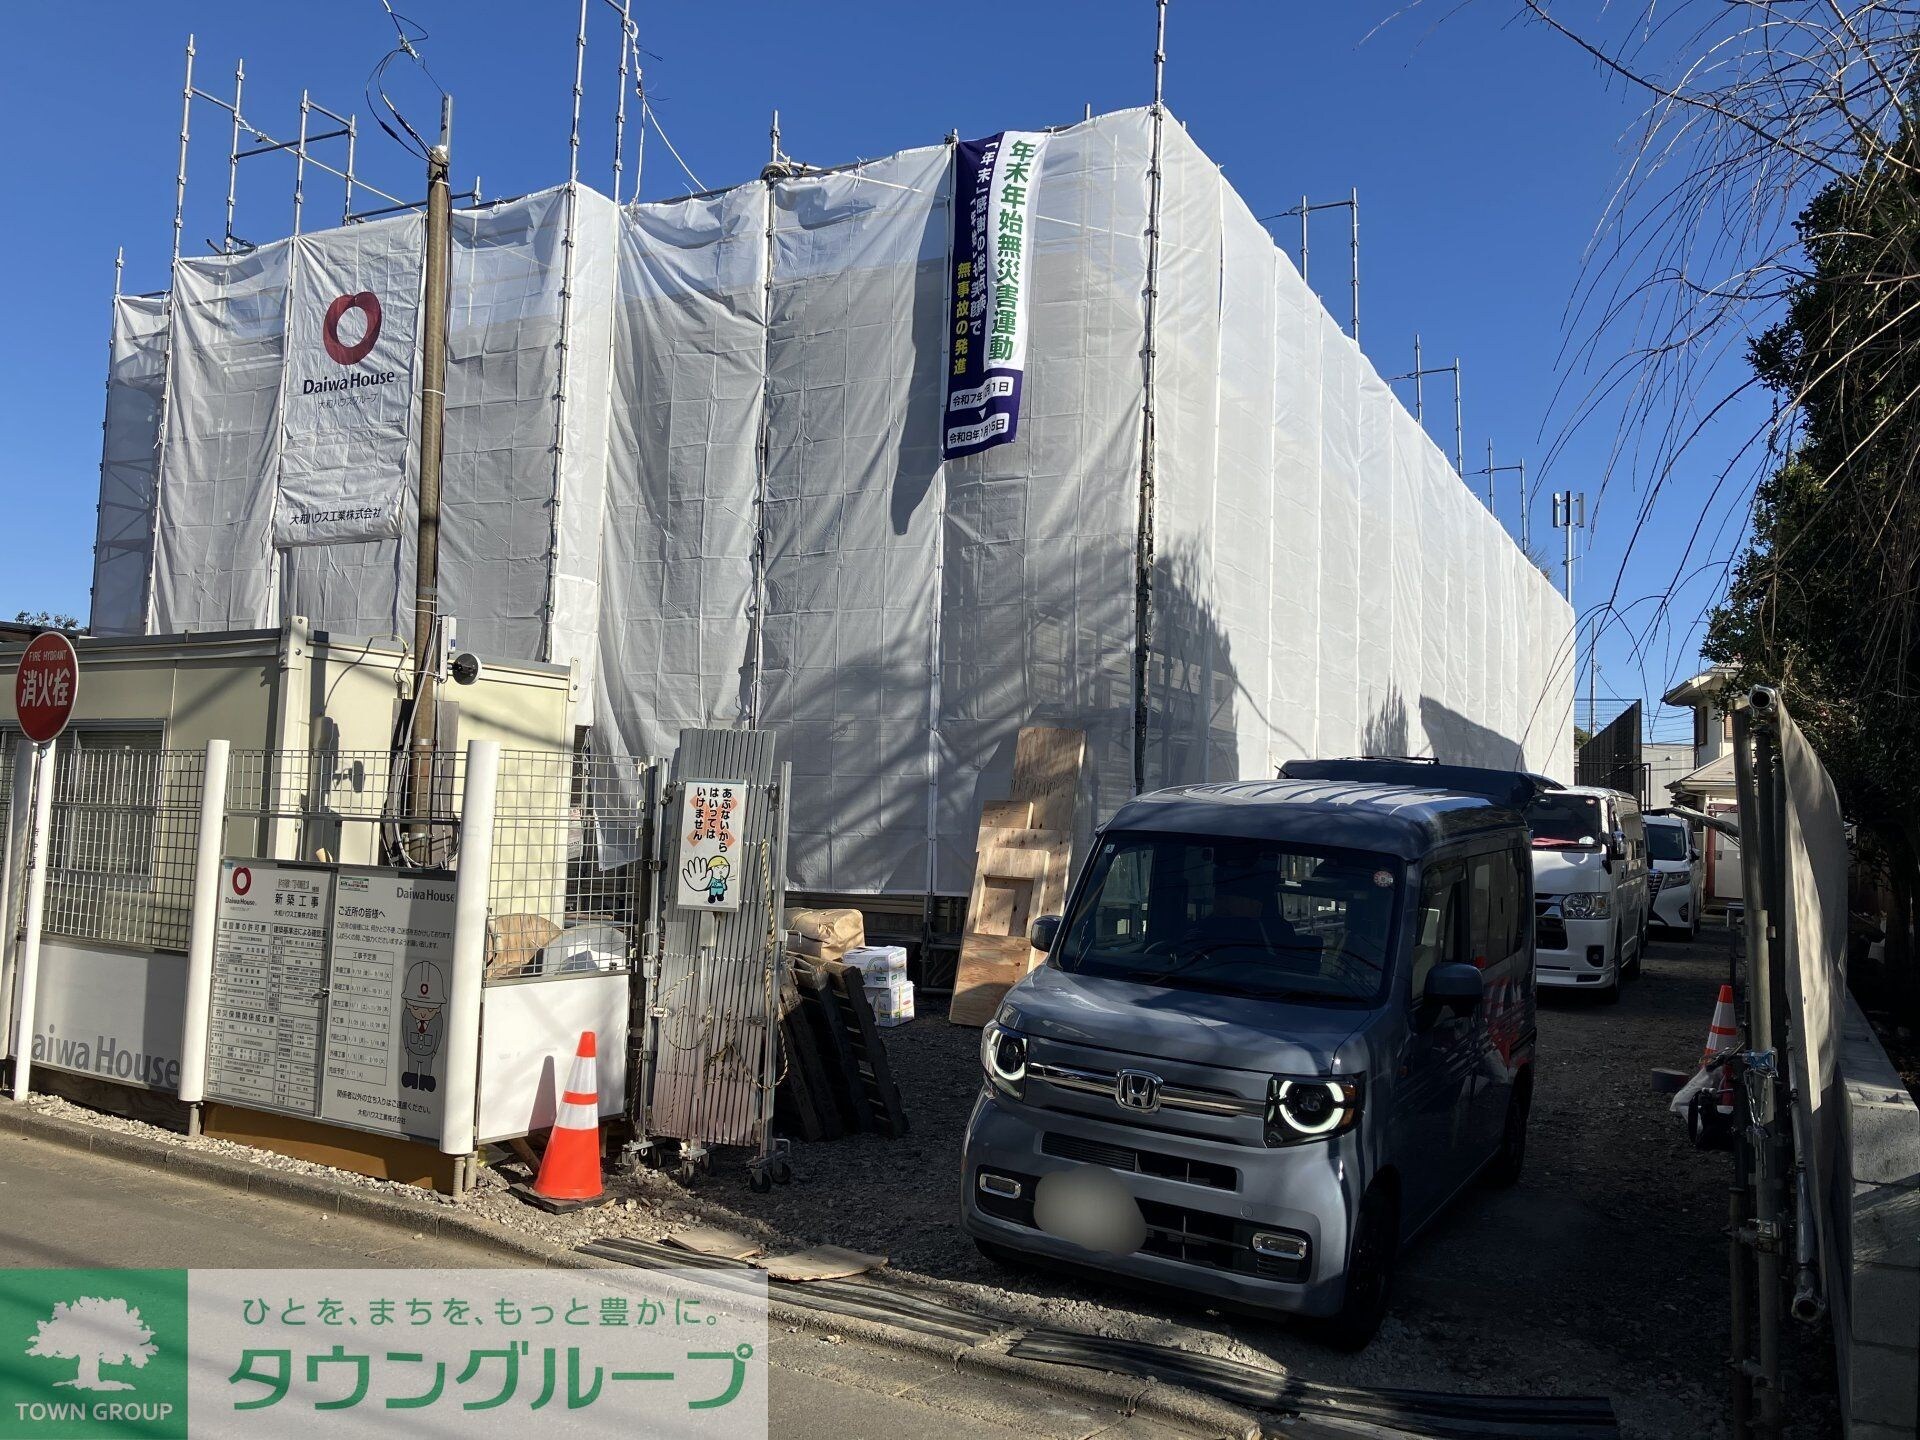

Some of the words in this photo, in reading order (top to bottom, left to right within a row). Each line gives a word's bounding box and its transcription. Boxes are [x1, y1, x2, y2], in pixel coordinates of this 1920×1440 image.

[989, 140, 1036, 360] 年末年始無災害運動
[954, 262, 972, 375] 無事故の発進
[303, 376, 347, 394] Daiwa
[350, 371, 395, 388] House
[953, 382, 1009, 407] 令和7年月1日
[950, 419, 1005, 444] 令和8年1月15日
[289, 507, 381, 525] 大和ハウス工業株式会社
[29, 650, 41, 661] FIRE
[43, 650, 67, 661] HYDRANT
[20, 667, 71, 707] 消火栓
[693, 787, 706, 841] いけません
[706, 787, 719, 839] はいっては
[718, 788, 732, 853] あぶないから
[274, 893, 319, 908] 新築工事
[396, 887, 425, 900] Daiwa
[426, 889, 455, 903] House
[338, 906, 386, 919] ご近所の皆様へ
[15, 1021, 90, 1070] aiwa
[95, 1035, 180, 1088] House
